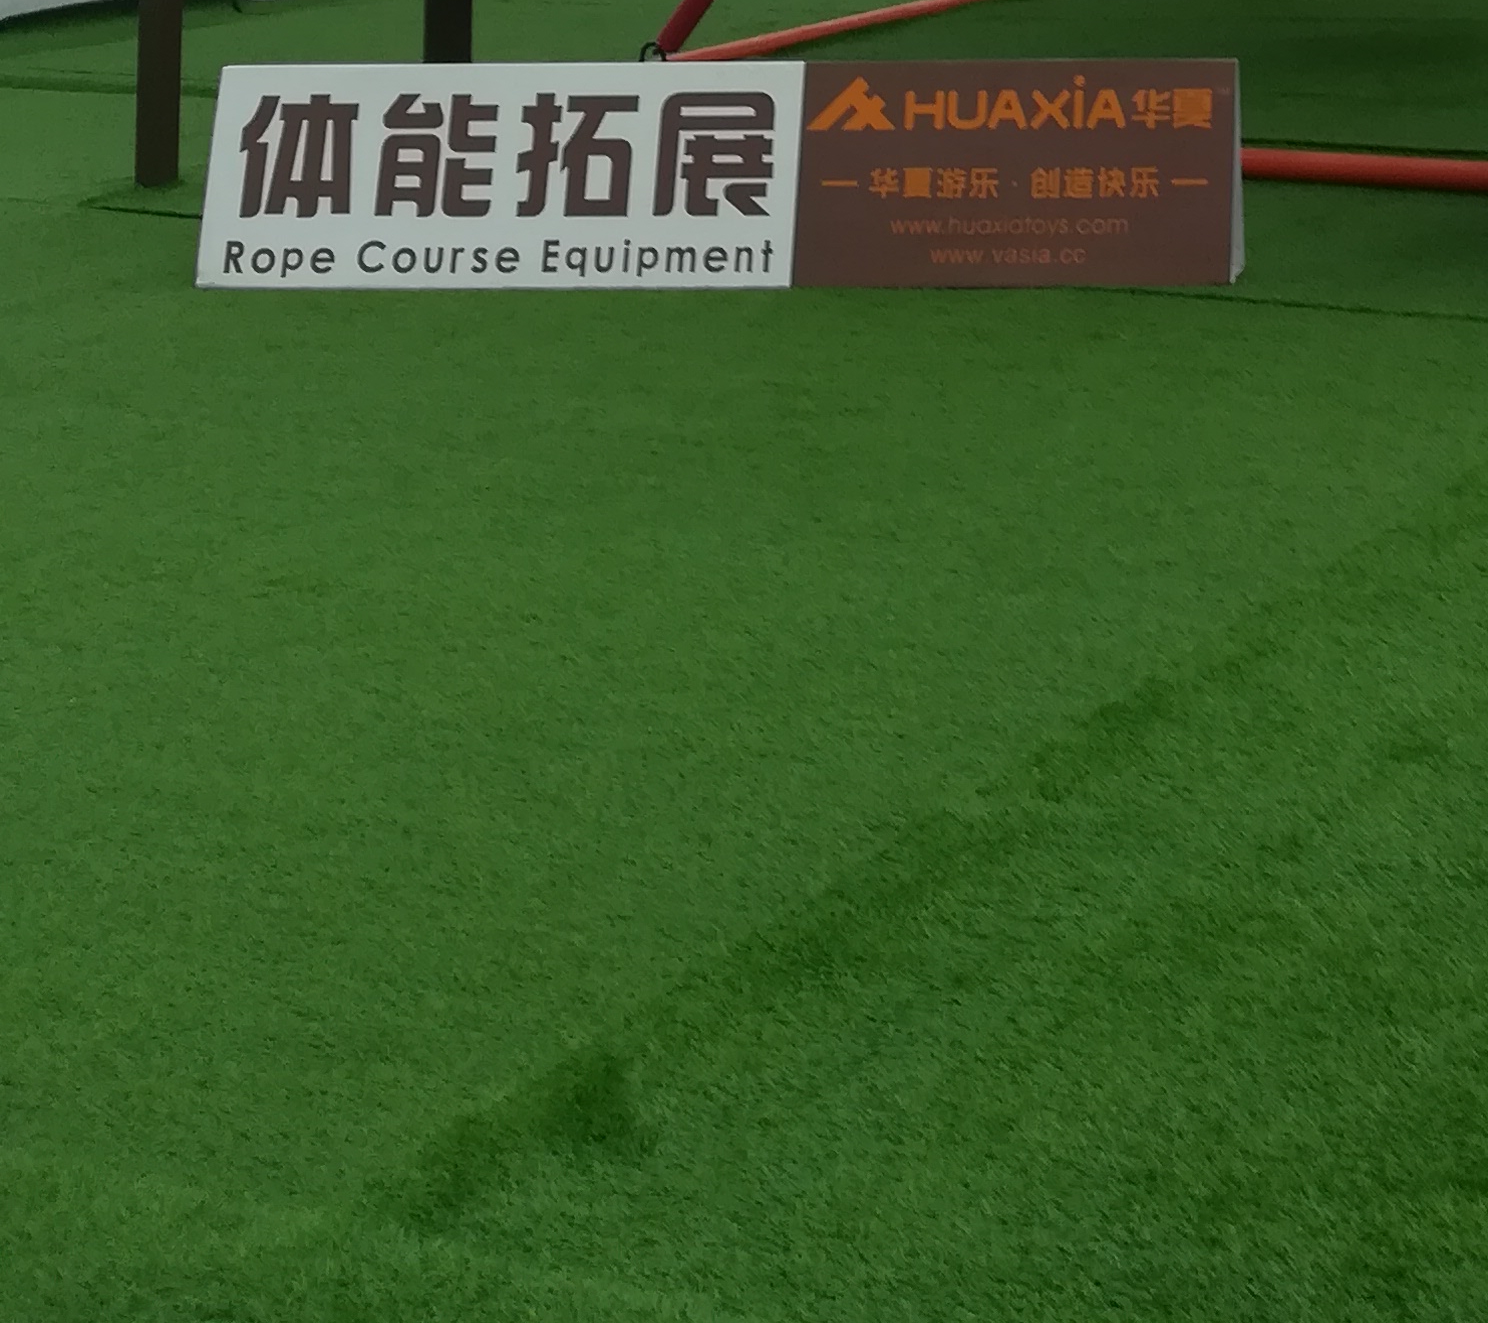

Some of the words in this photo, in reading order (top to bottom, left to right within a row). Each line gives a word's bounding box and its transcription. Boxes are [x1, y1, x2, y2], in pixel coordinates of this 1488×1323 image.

[238, 91, 776, 219] 体能拓展
[222, 240, 336, 278] Rope
[357, 240, 520, 274] Course
[541, 238, 775, 278] Equipment
